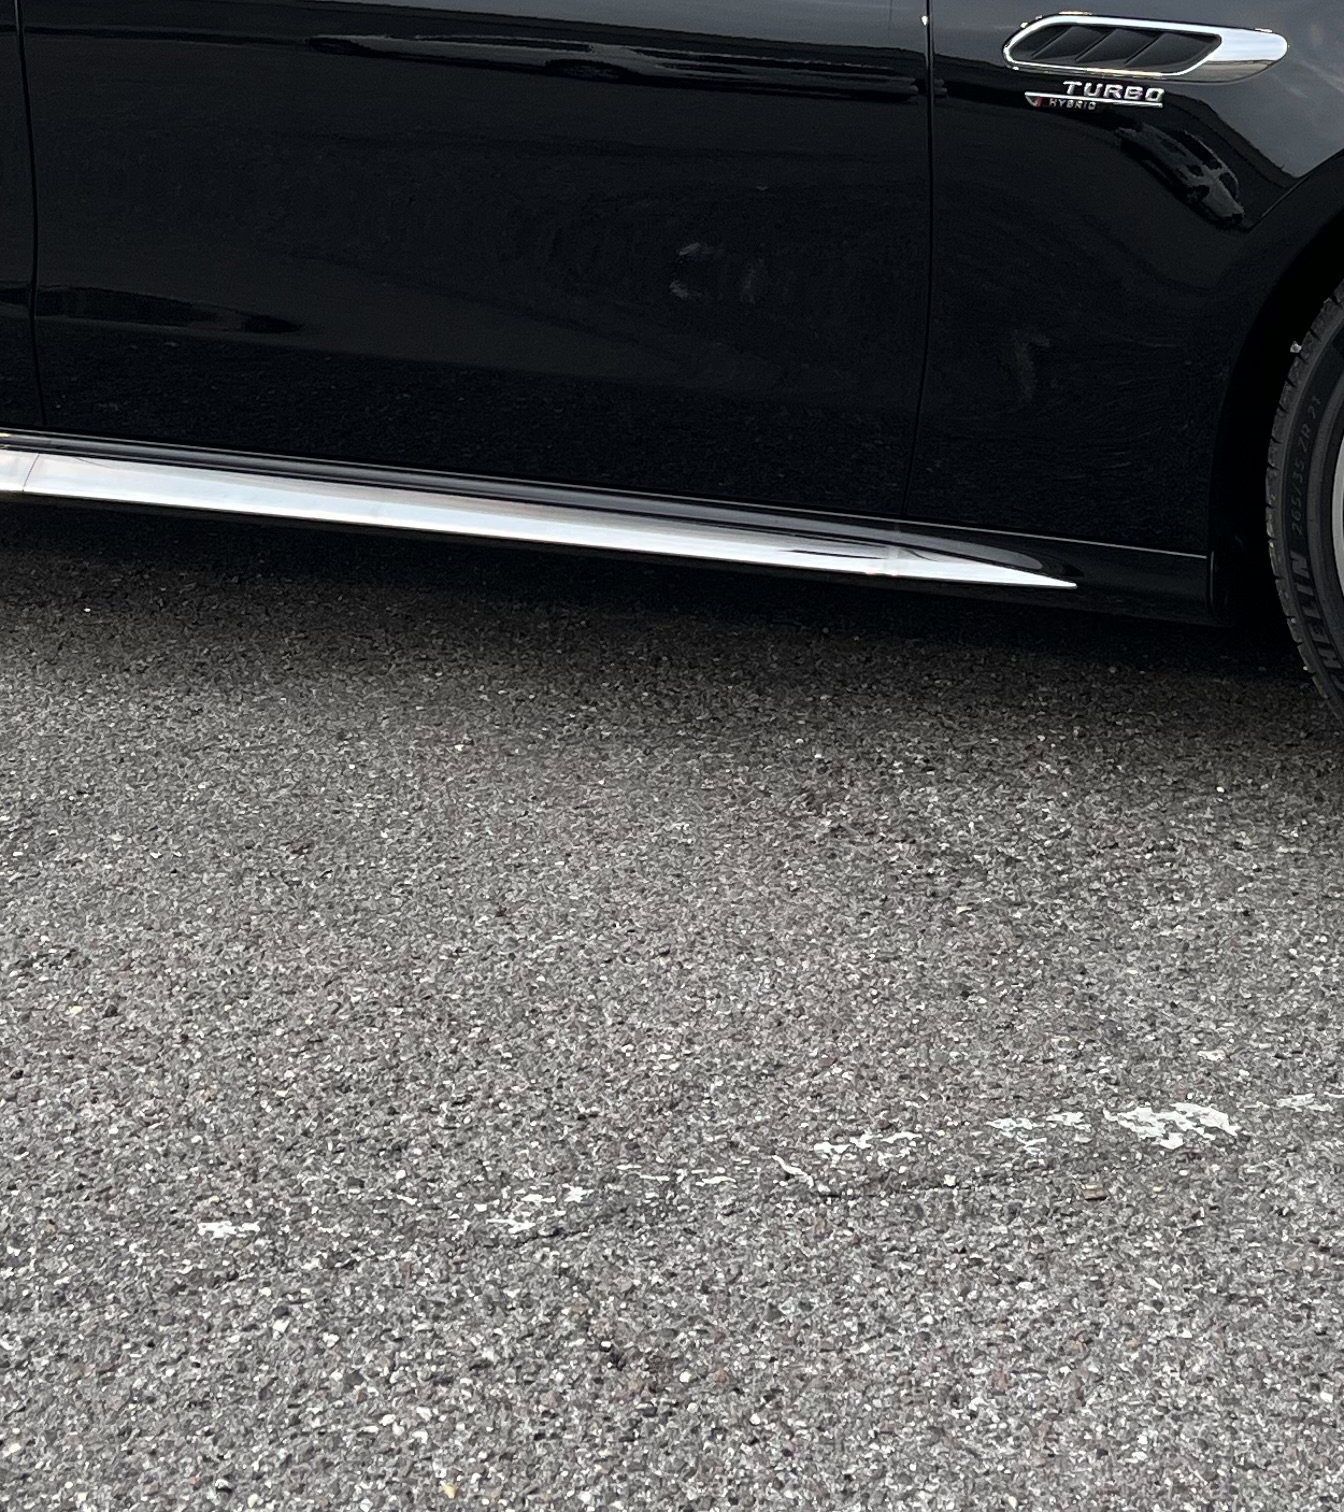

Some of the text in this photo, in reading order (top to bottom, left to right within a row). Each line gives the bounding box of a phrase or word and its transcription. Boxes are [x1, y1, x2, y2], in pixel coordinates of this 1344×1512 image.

[1062, 80, 1164, 102] TURBO
[1049, 98, 1097, 110] HYBRID
[1297, 423, 1313, 454] ZR
